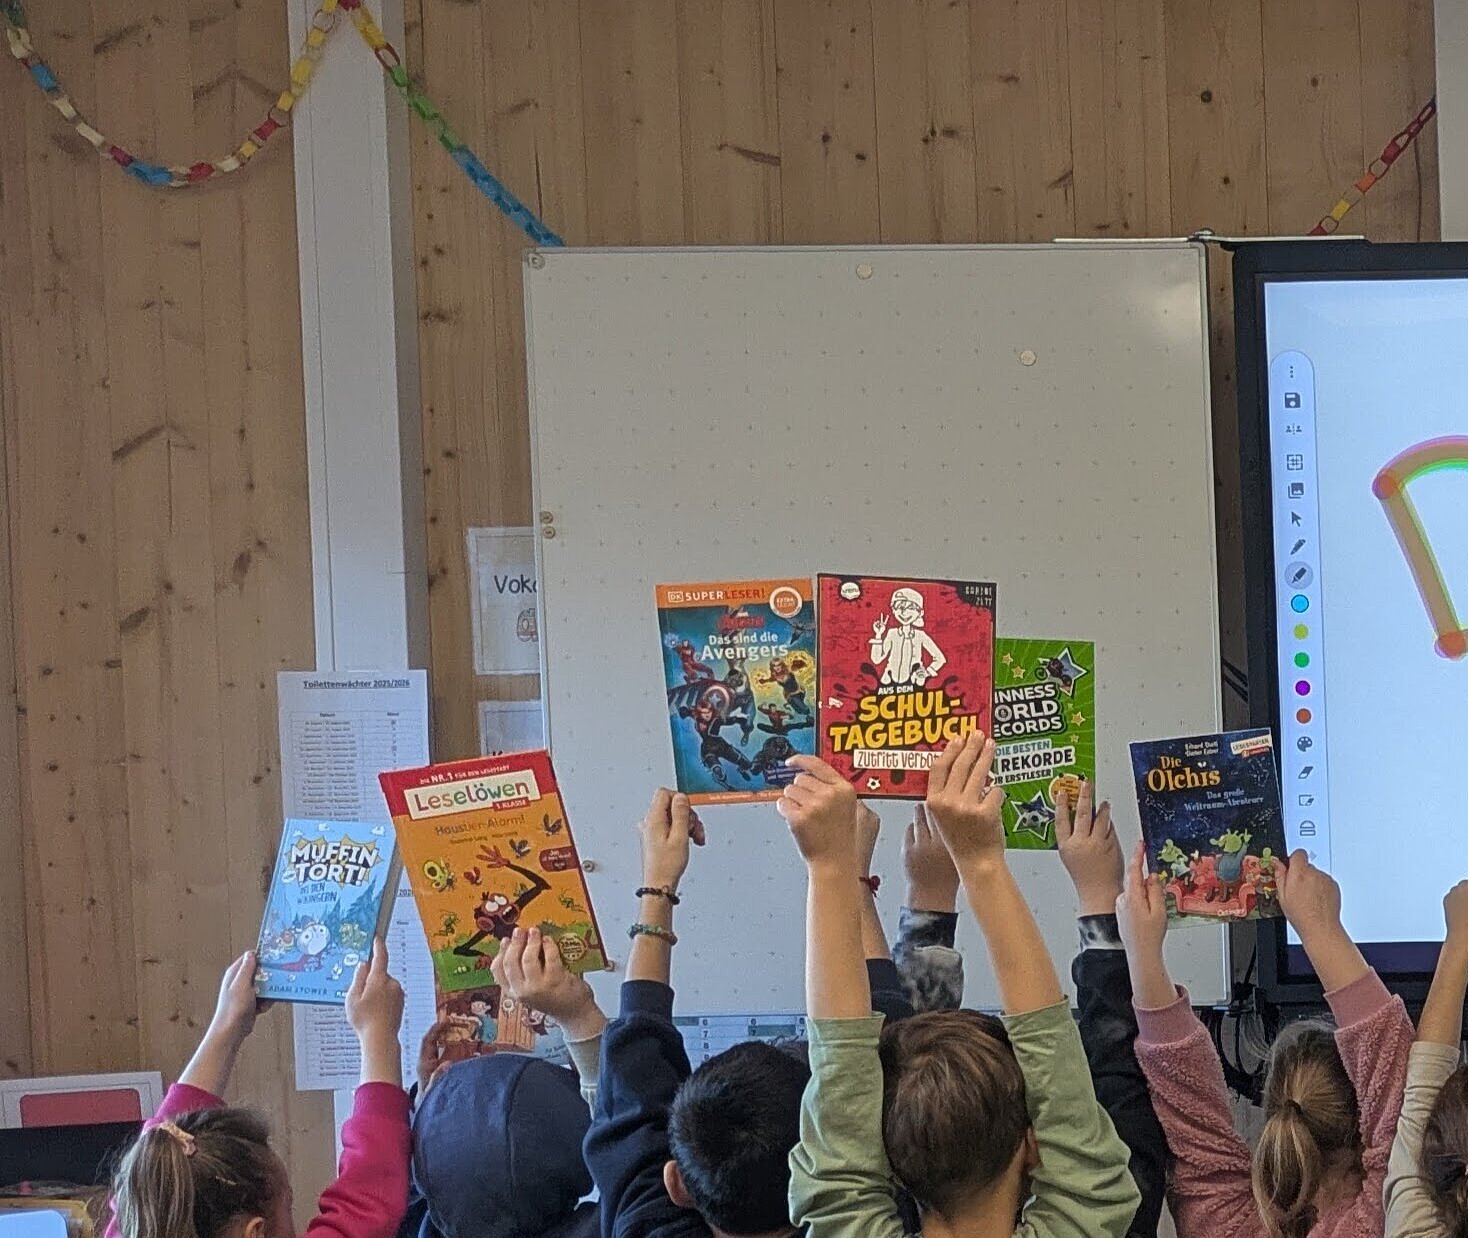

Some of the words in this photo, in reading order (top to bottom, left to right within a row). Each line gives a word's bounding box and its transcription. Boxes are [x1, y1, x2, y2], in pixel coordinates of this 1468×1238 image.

[708, 634, 730, 646] Das
[732, 632, 757, 644] sind
[760, 632, 779, 643] die
[702, 642, 788, 662] Avengers
[303, 679, 372, 690] Toilettenwächter
[878, 686, 895, 696] AUS
[858, 690, 961, 722] SCHUL-
[995, 700, 1058, 724] ORLD
[829, 716, 977, 753] TAGEBUCH
[994, 717, 1063, 737] ECORDS
[1012, 740, 1050, 754] BESTEN
[1000, 748, 1074, 773] REKORDE
[1160, 756, 1182, 770] Die
[1005, 769, 1052, 784] ERSTLESER
[1148, 766, 1221, 793] Olchis
[414, 780, 530, 812] Leselöwen
[292, 842, 379, 868] MUFFIN
[295, 862, 366, 887] TORT!
